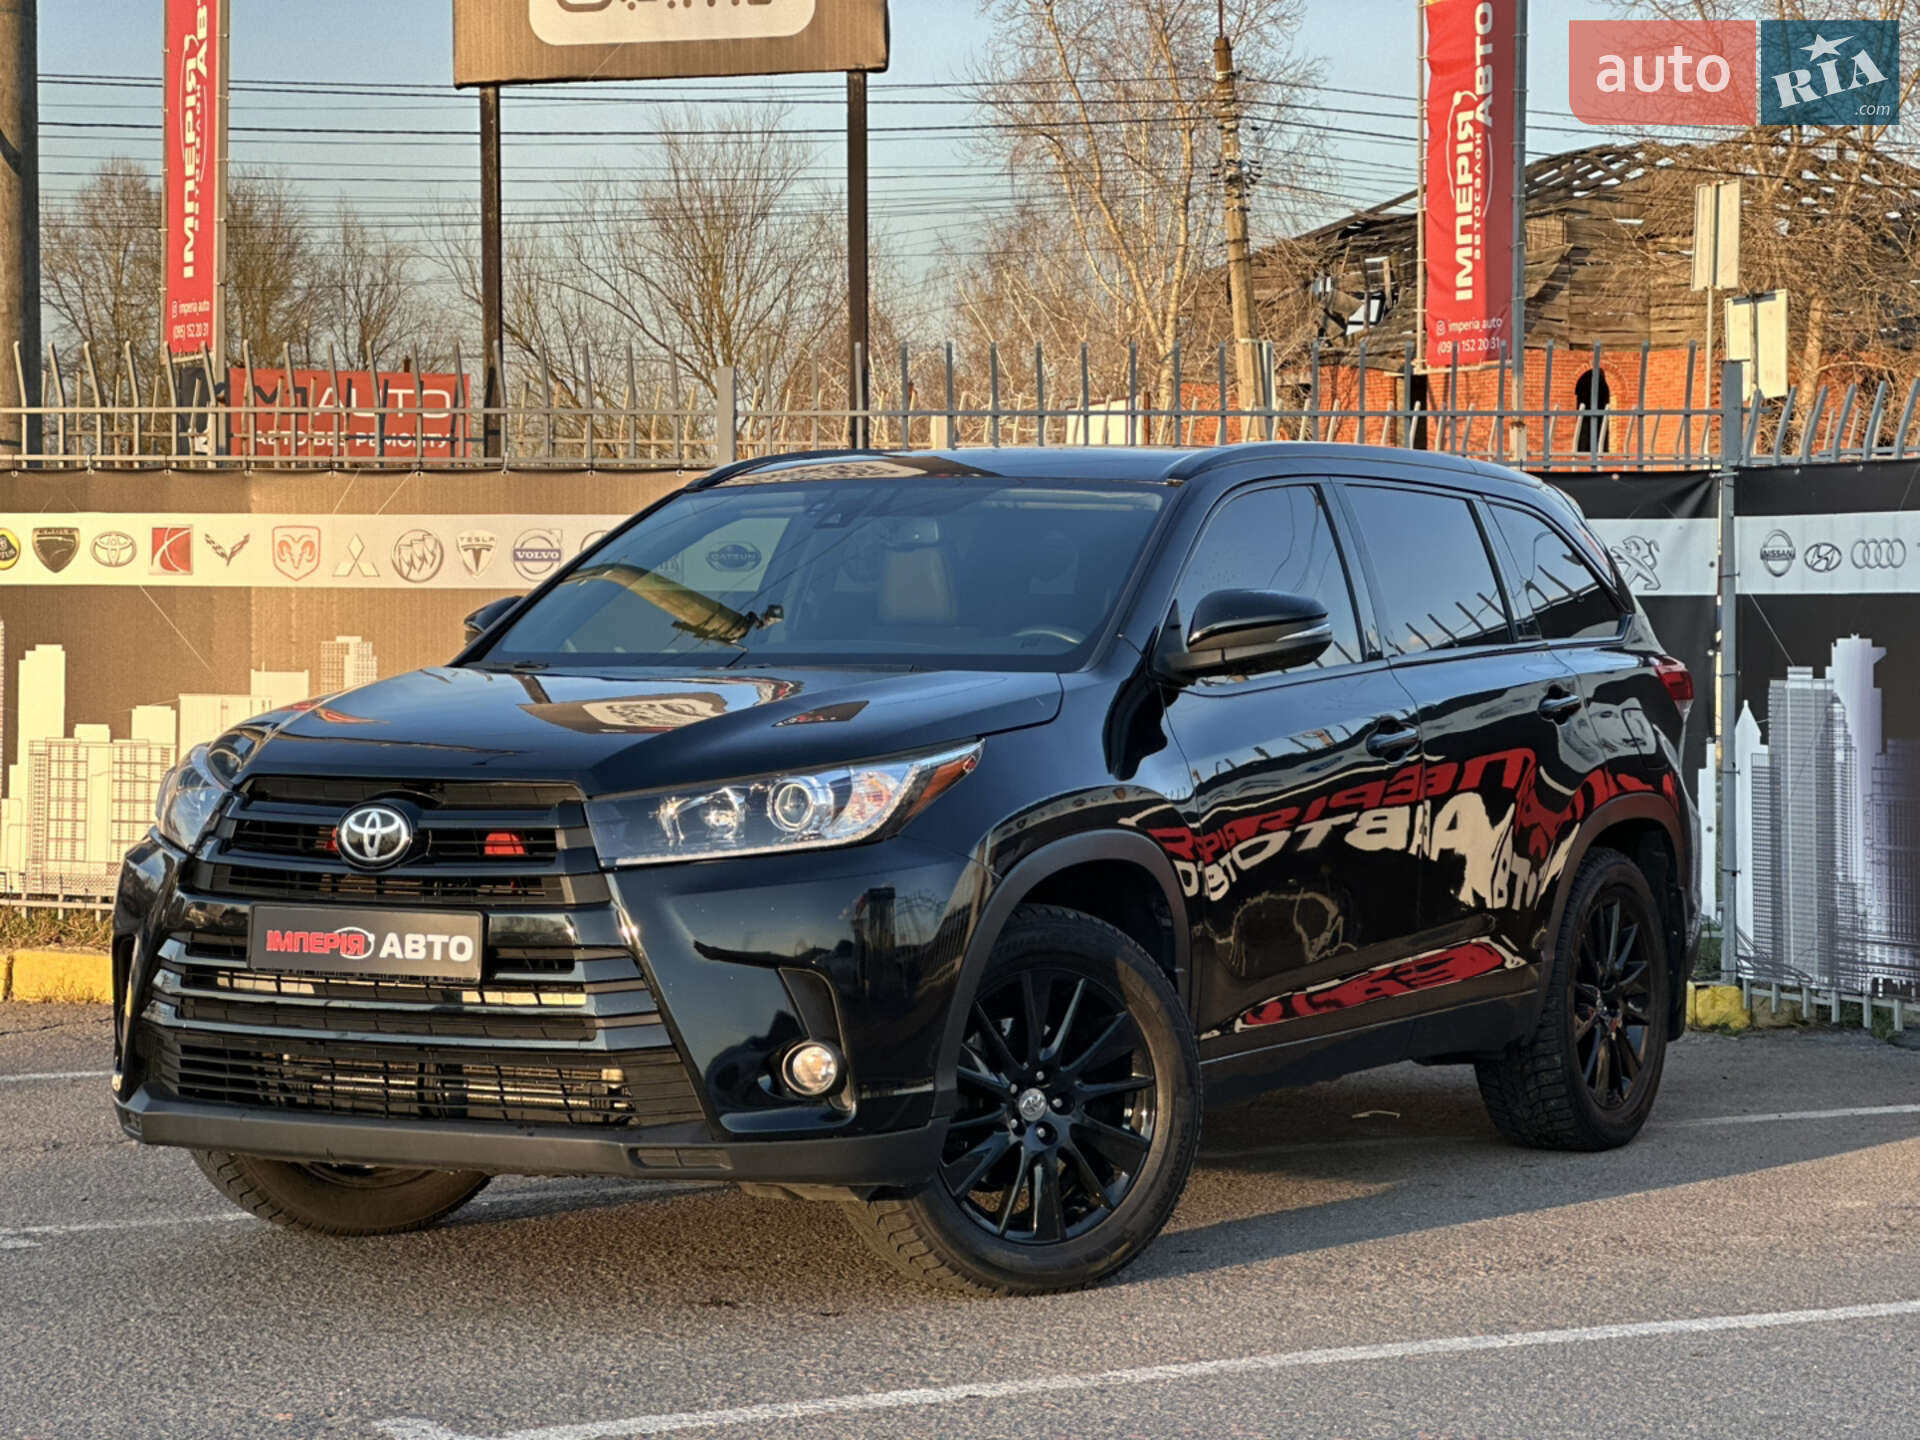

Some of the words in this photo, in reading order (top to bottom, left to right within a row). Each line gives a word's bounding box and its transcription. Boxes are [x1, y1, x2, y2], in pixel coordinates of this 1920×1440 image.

[1475, 2, 1494, 128] АВТО
[1455, 109, 1475, 301] ІМПЕРІЯ
[1437, 340, 1460, 355] (09)
[1462, 338, 1476, 352] 152
[1477, 337, 1489, 351] 20
[1490, 336, 1500, 350] 31
[515, 551, 560, 559] VOLVO
[1763, 549, 1793, 558] NISSAN
[265, 929, 365, 956] ІМПЕРІЯ
[379, 931, 474, 963] АВТО
